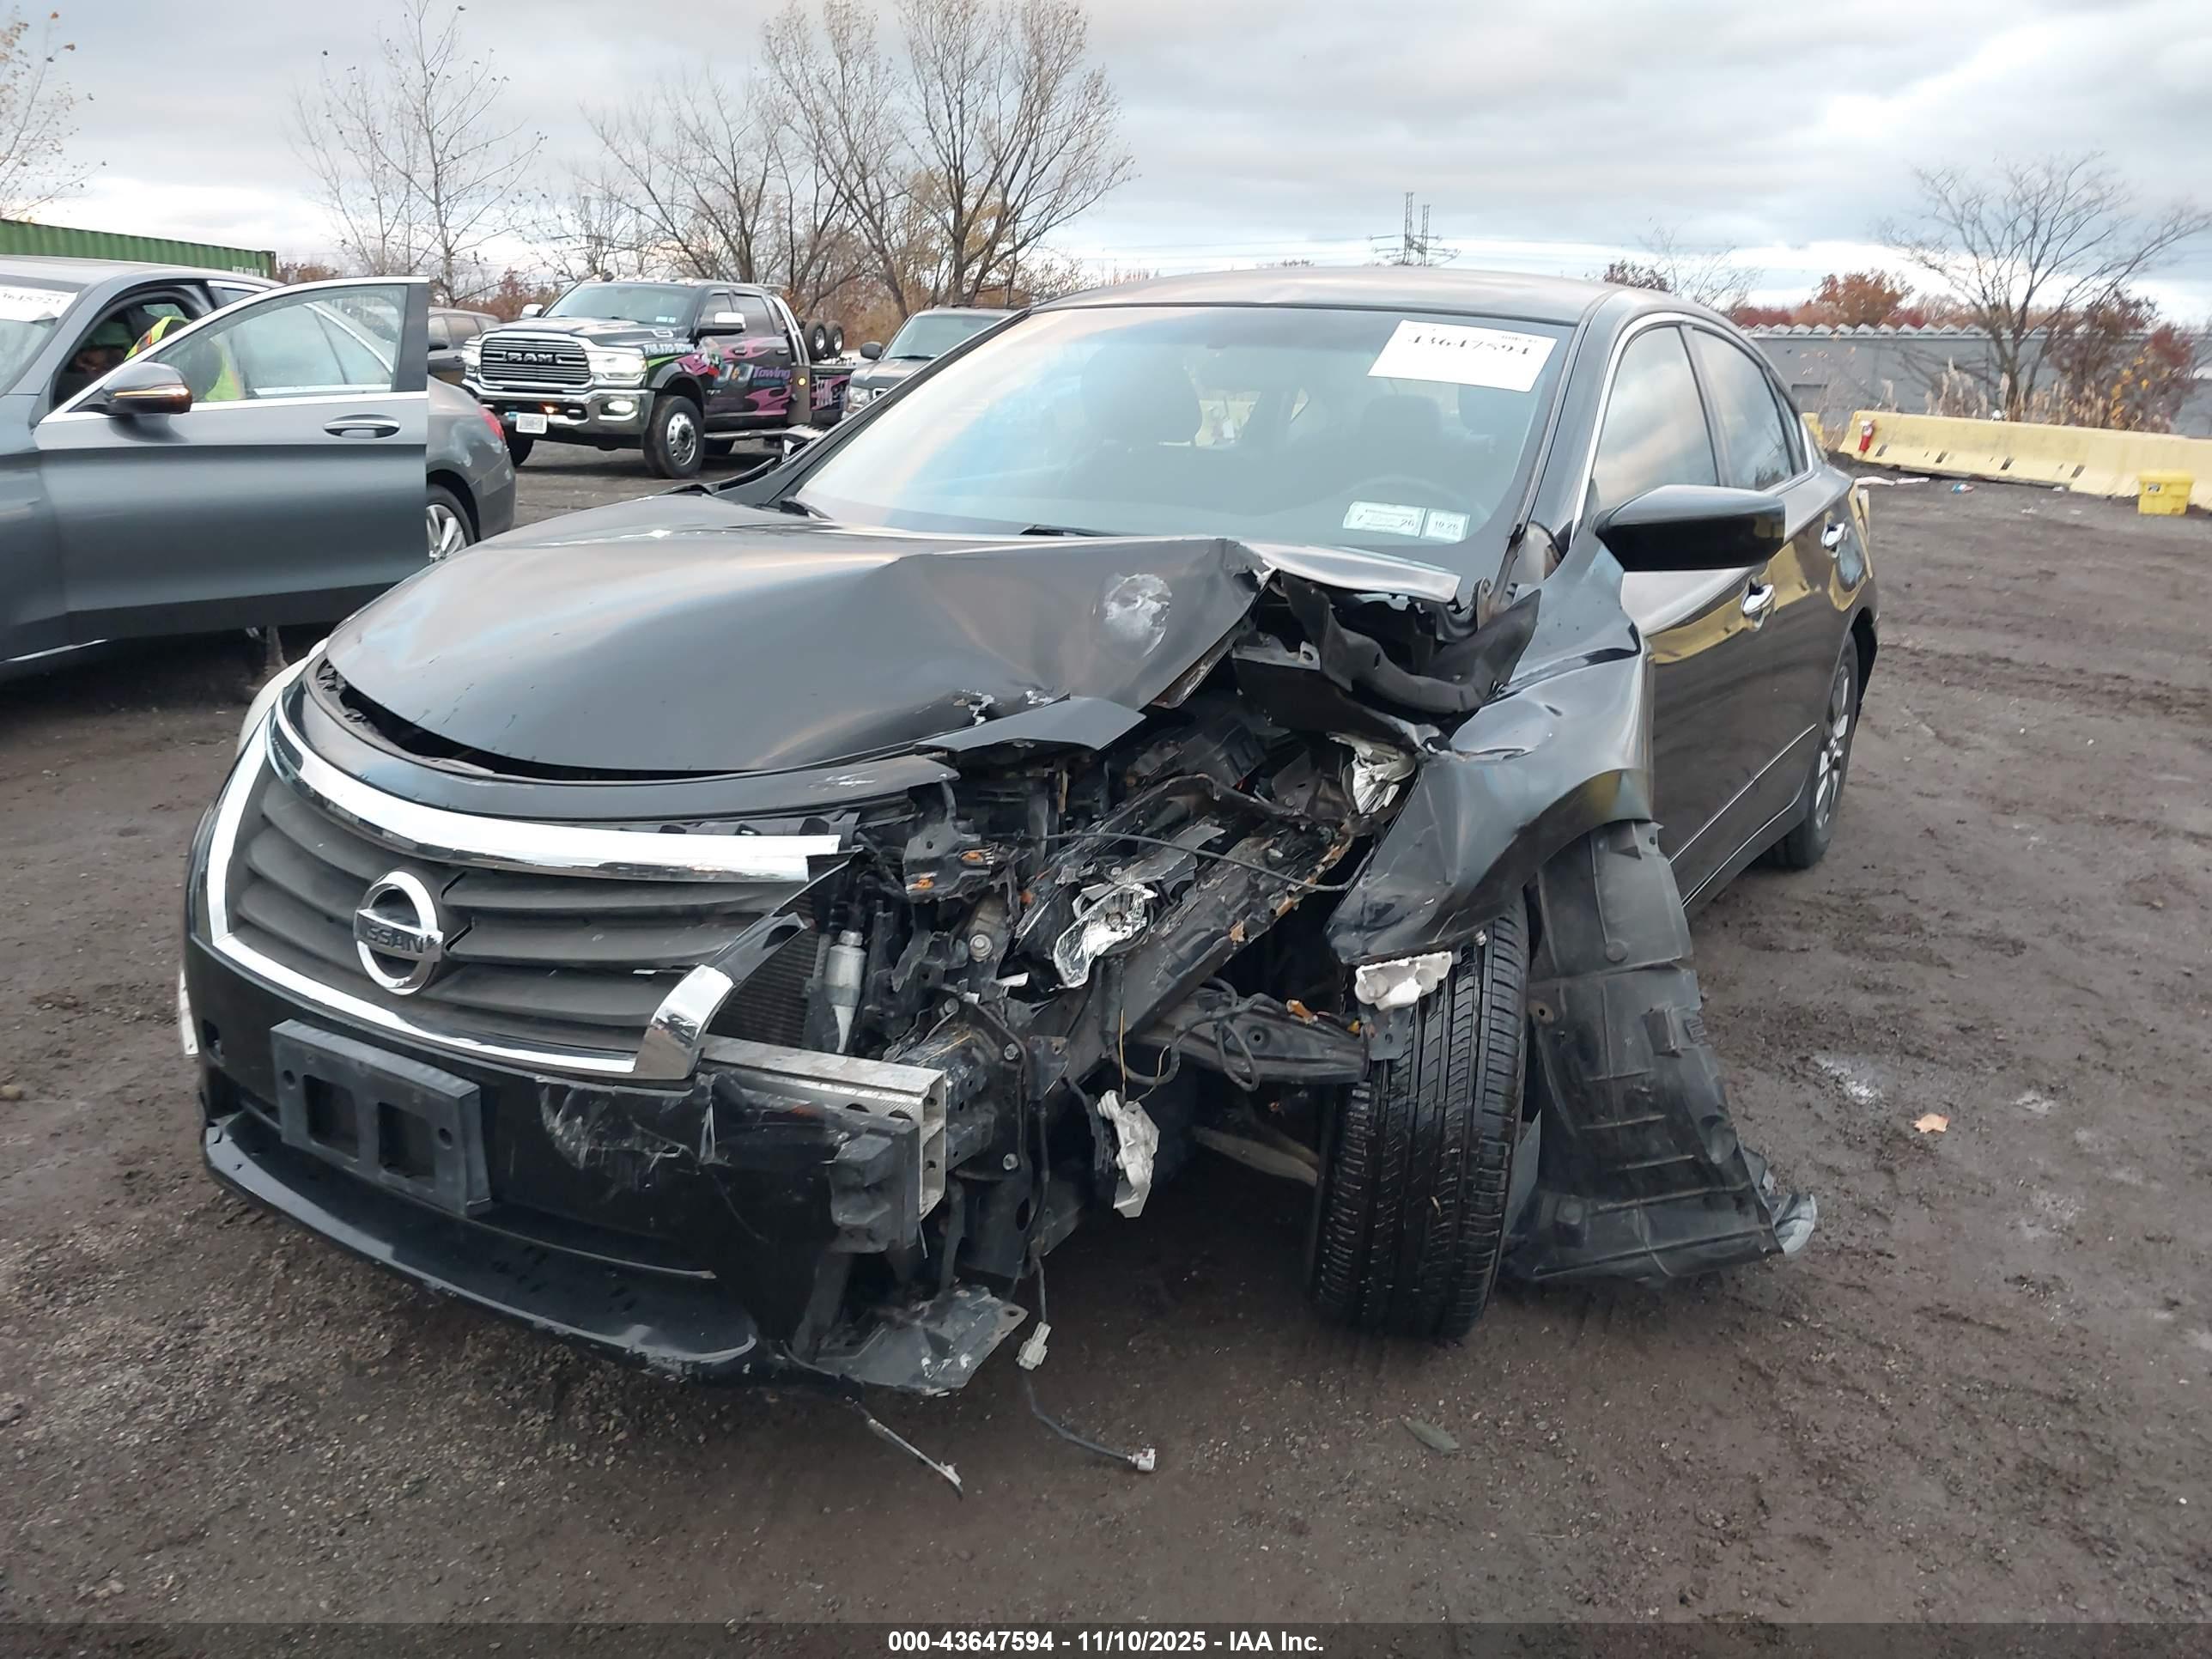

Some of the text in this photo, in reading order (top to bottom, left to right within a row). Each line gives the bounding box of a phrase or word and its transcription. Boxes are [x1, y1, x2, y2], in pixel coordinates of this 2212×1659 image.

[507, 352, 554, 362] RAM
[752, 366, 791, 380] Towing
[358, 918, 424, 953] SSAN
